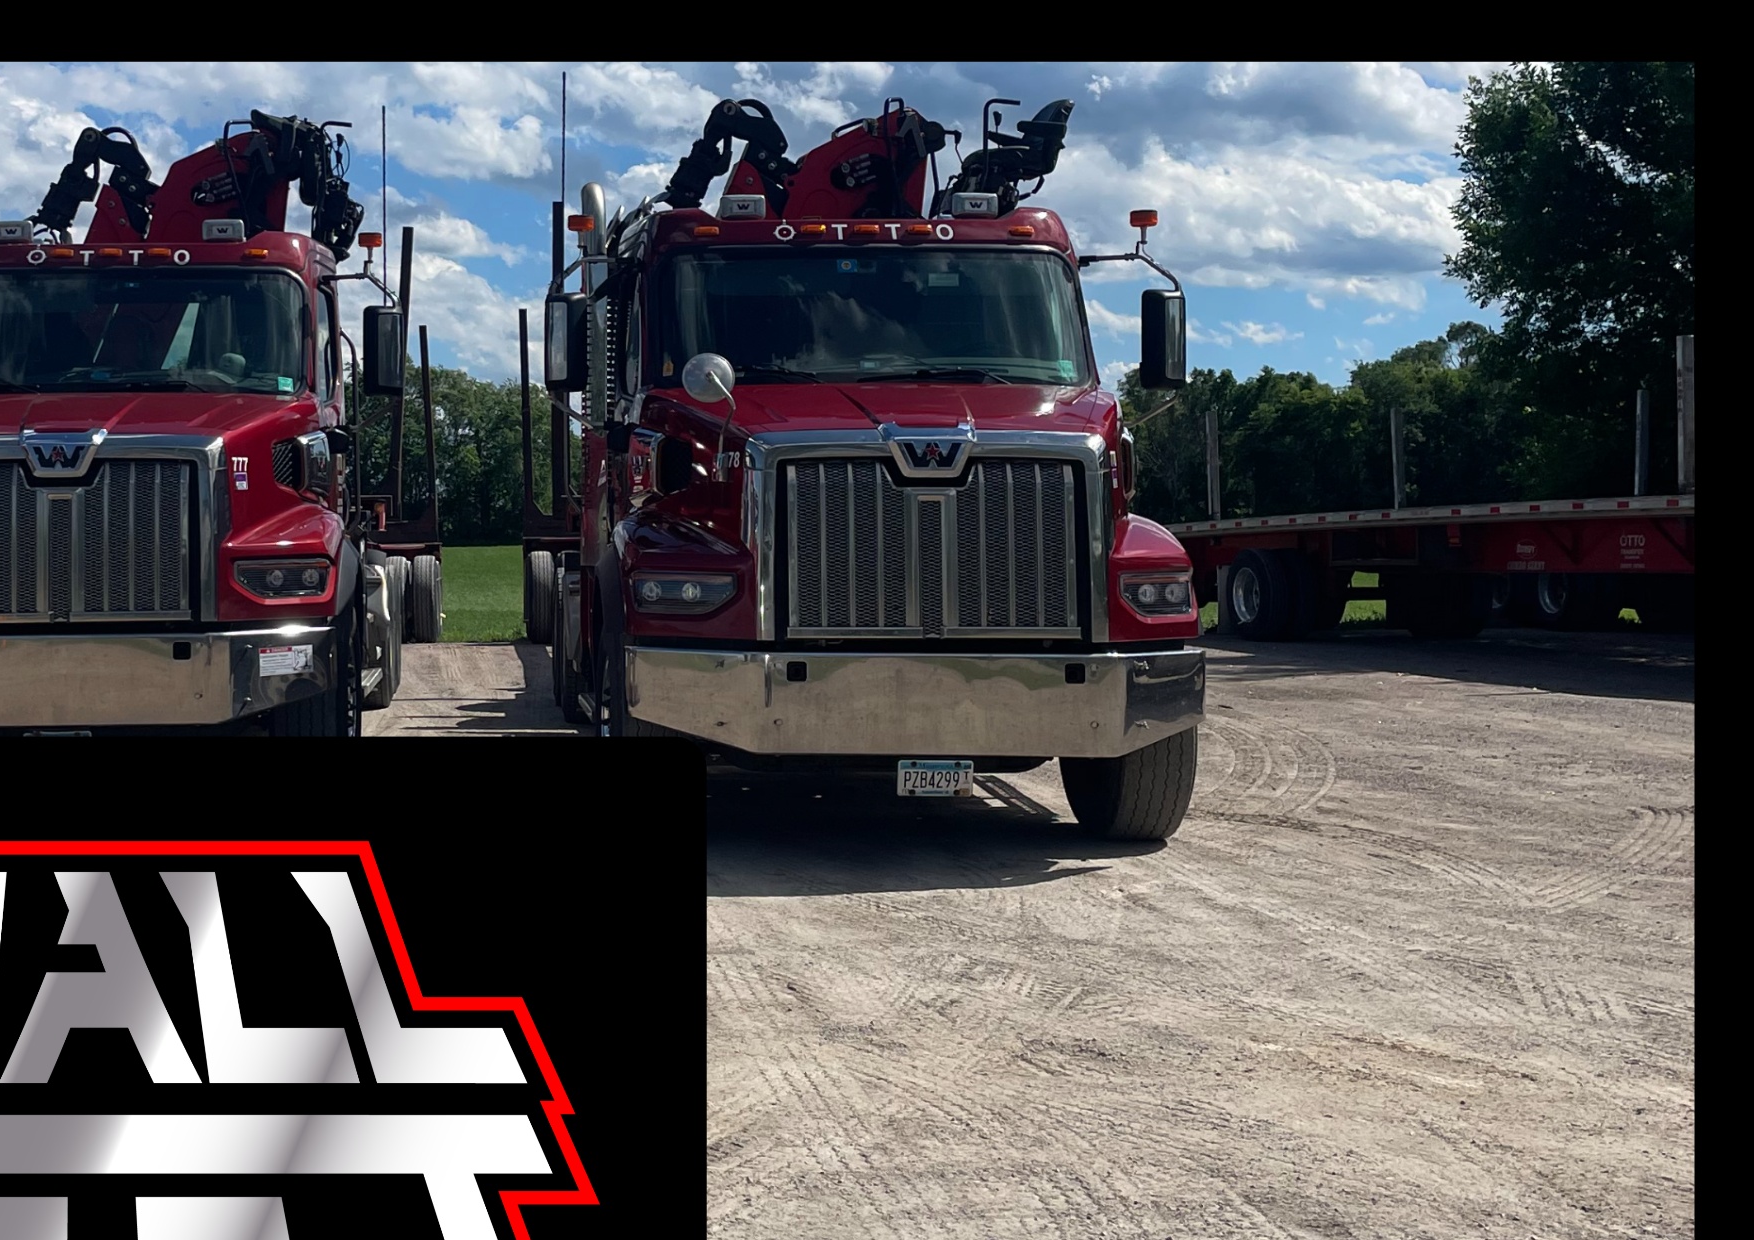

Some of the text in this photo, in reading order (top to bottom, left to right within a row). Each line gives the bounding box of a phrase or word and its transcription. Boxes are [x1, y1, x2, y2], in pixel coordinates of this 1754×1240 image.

[231, 456, 249, 472] 777
[1619, 534, 1646, 547] OTTO
[903, 770, 960, 789] PZB4299
